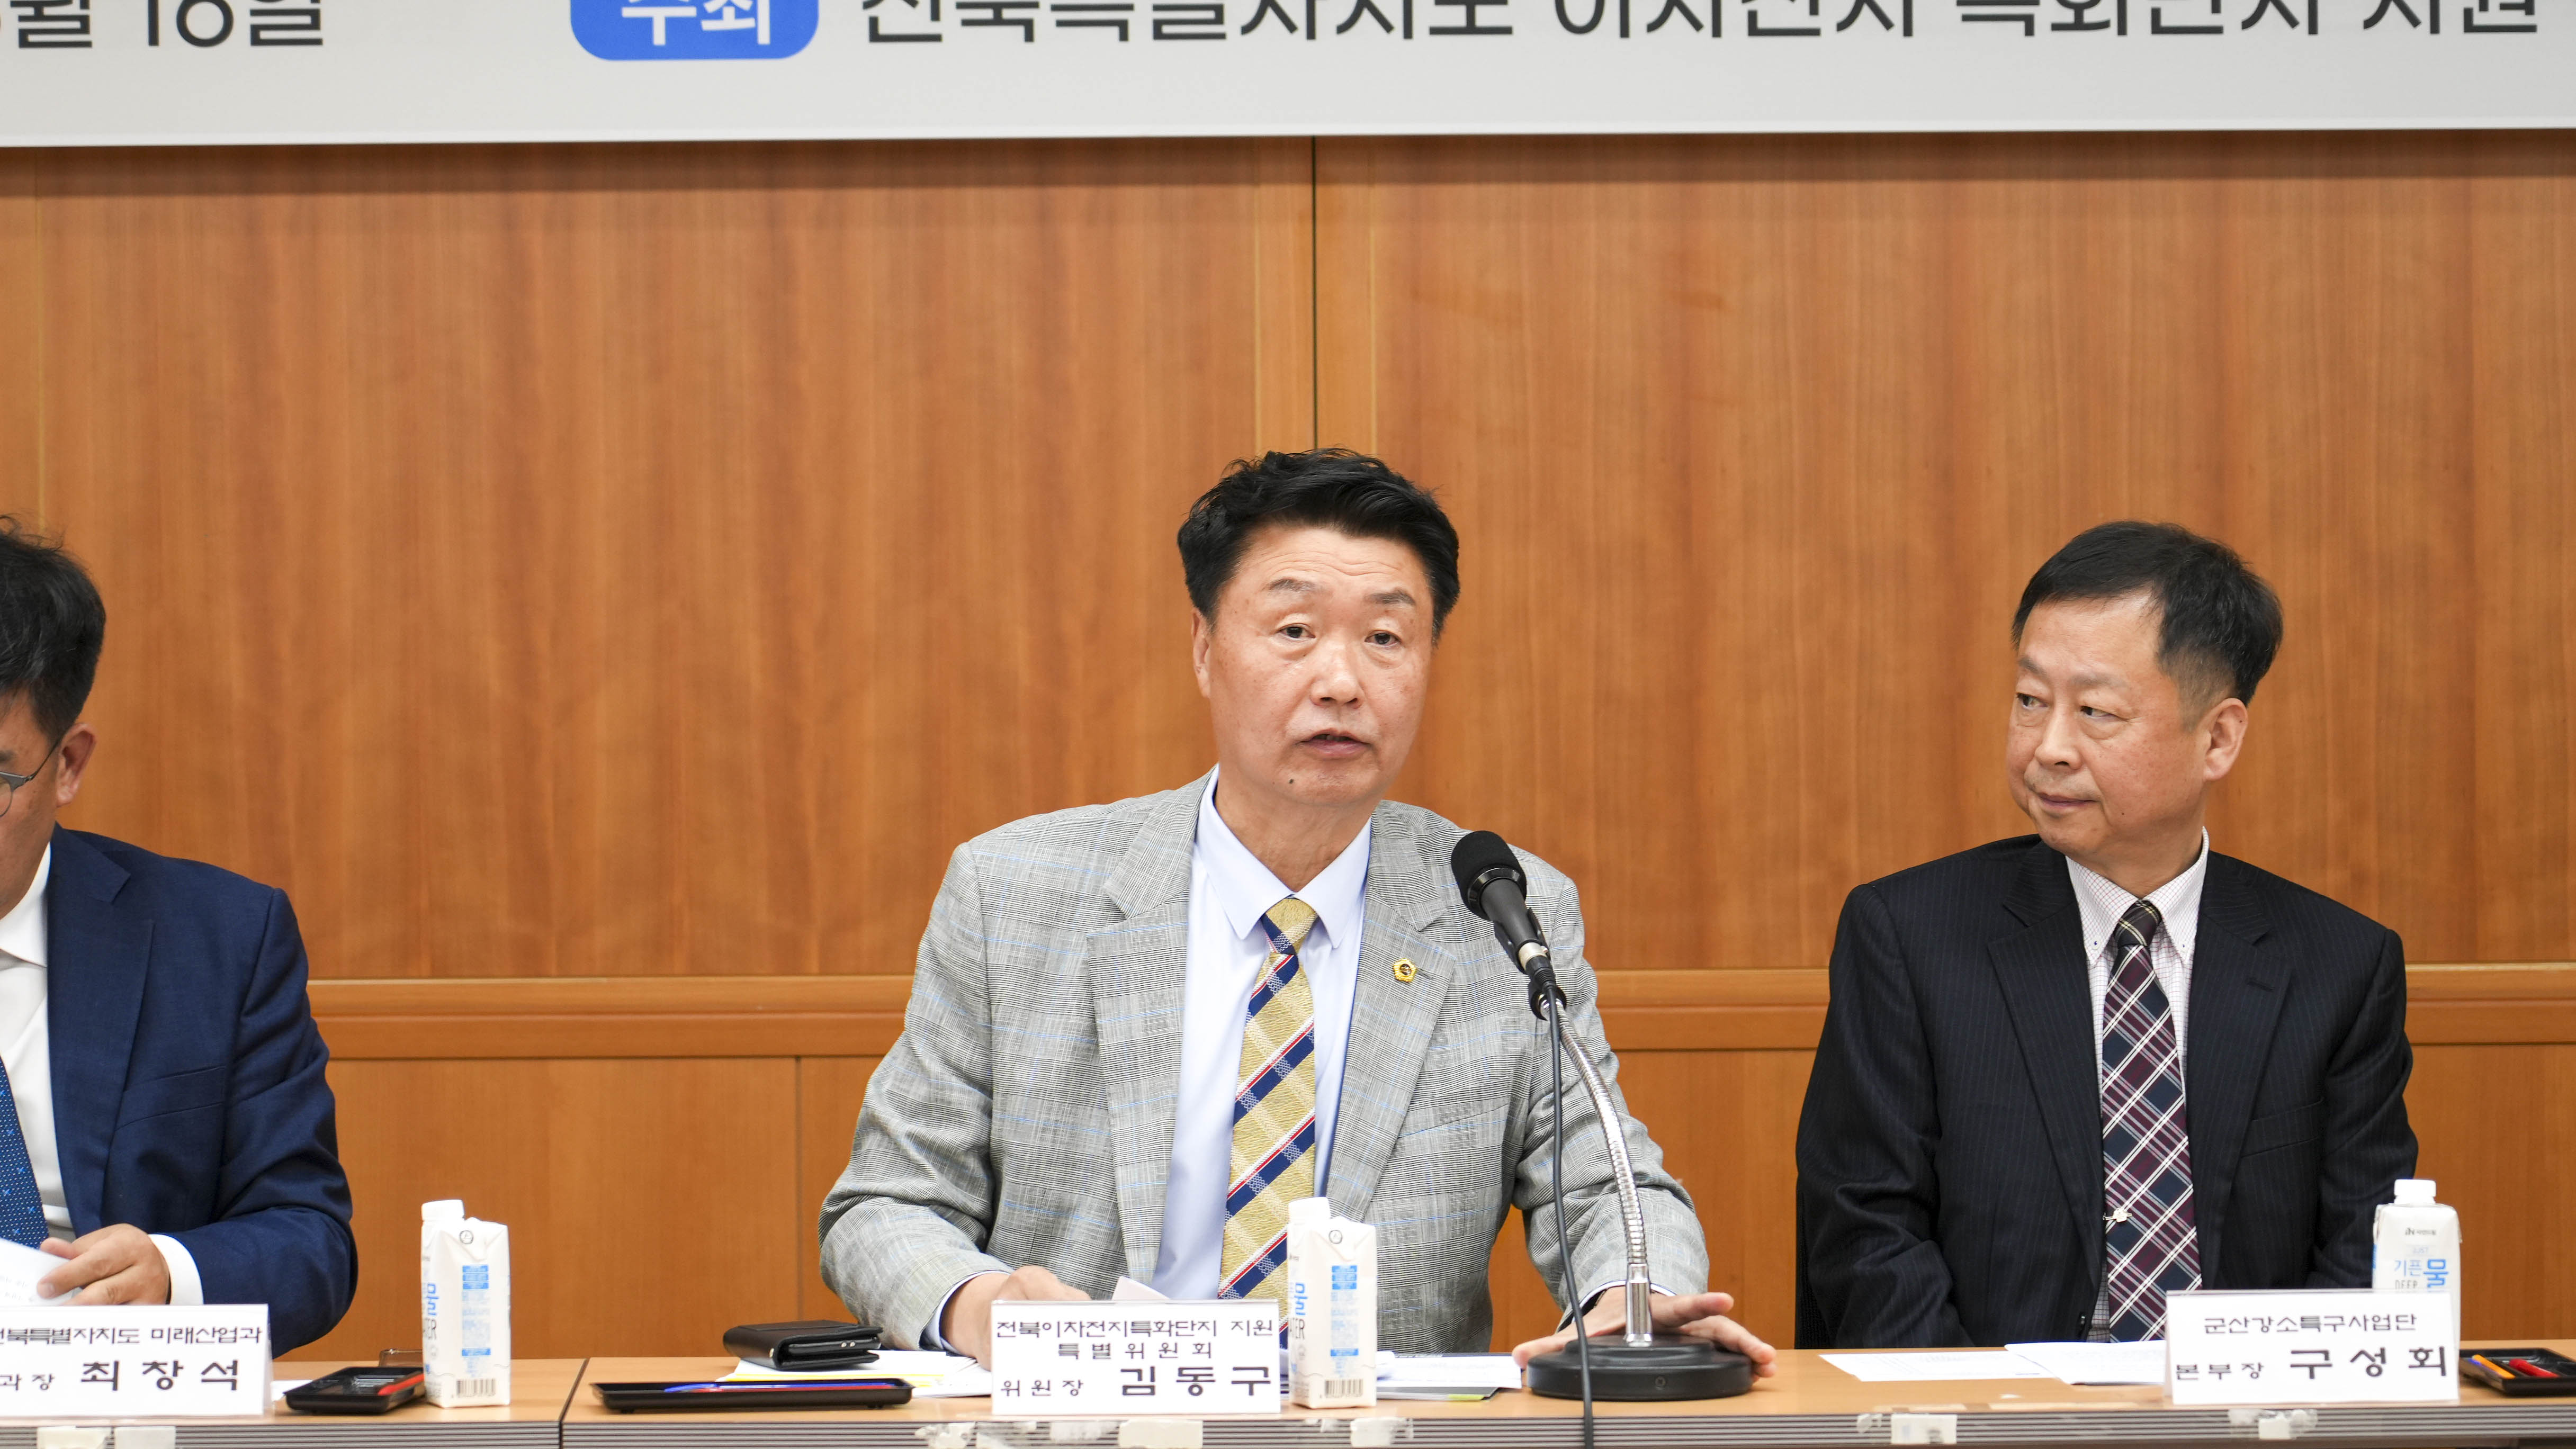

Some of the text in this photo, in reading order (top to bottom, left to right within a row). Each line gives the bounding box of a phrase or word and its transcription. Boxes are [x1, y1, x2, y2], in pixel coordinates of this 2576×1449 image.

[1294, 1283, 1308, 1316] 물
[151, 1327, 262, 1344] 미래산업과
[997, 1320, 1272, 1338] 전북이차전지특화단지 지원
[2204, 1314, 2417, 1334] 군산강소특구사업단
[1058, 1342, 1211, 1360] 특별위원회
[2176, 1346, 2446, 1381] 본부장 구성회
[80, 1360, 238, 1391] 최창석
[1000, 1380, 1084, 1397] 위원장
[1120, 1366, 1271, 1397] 김동구
